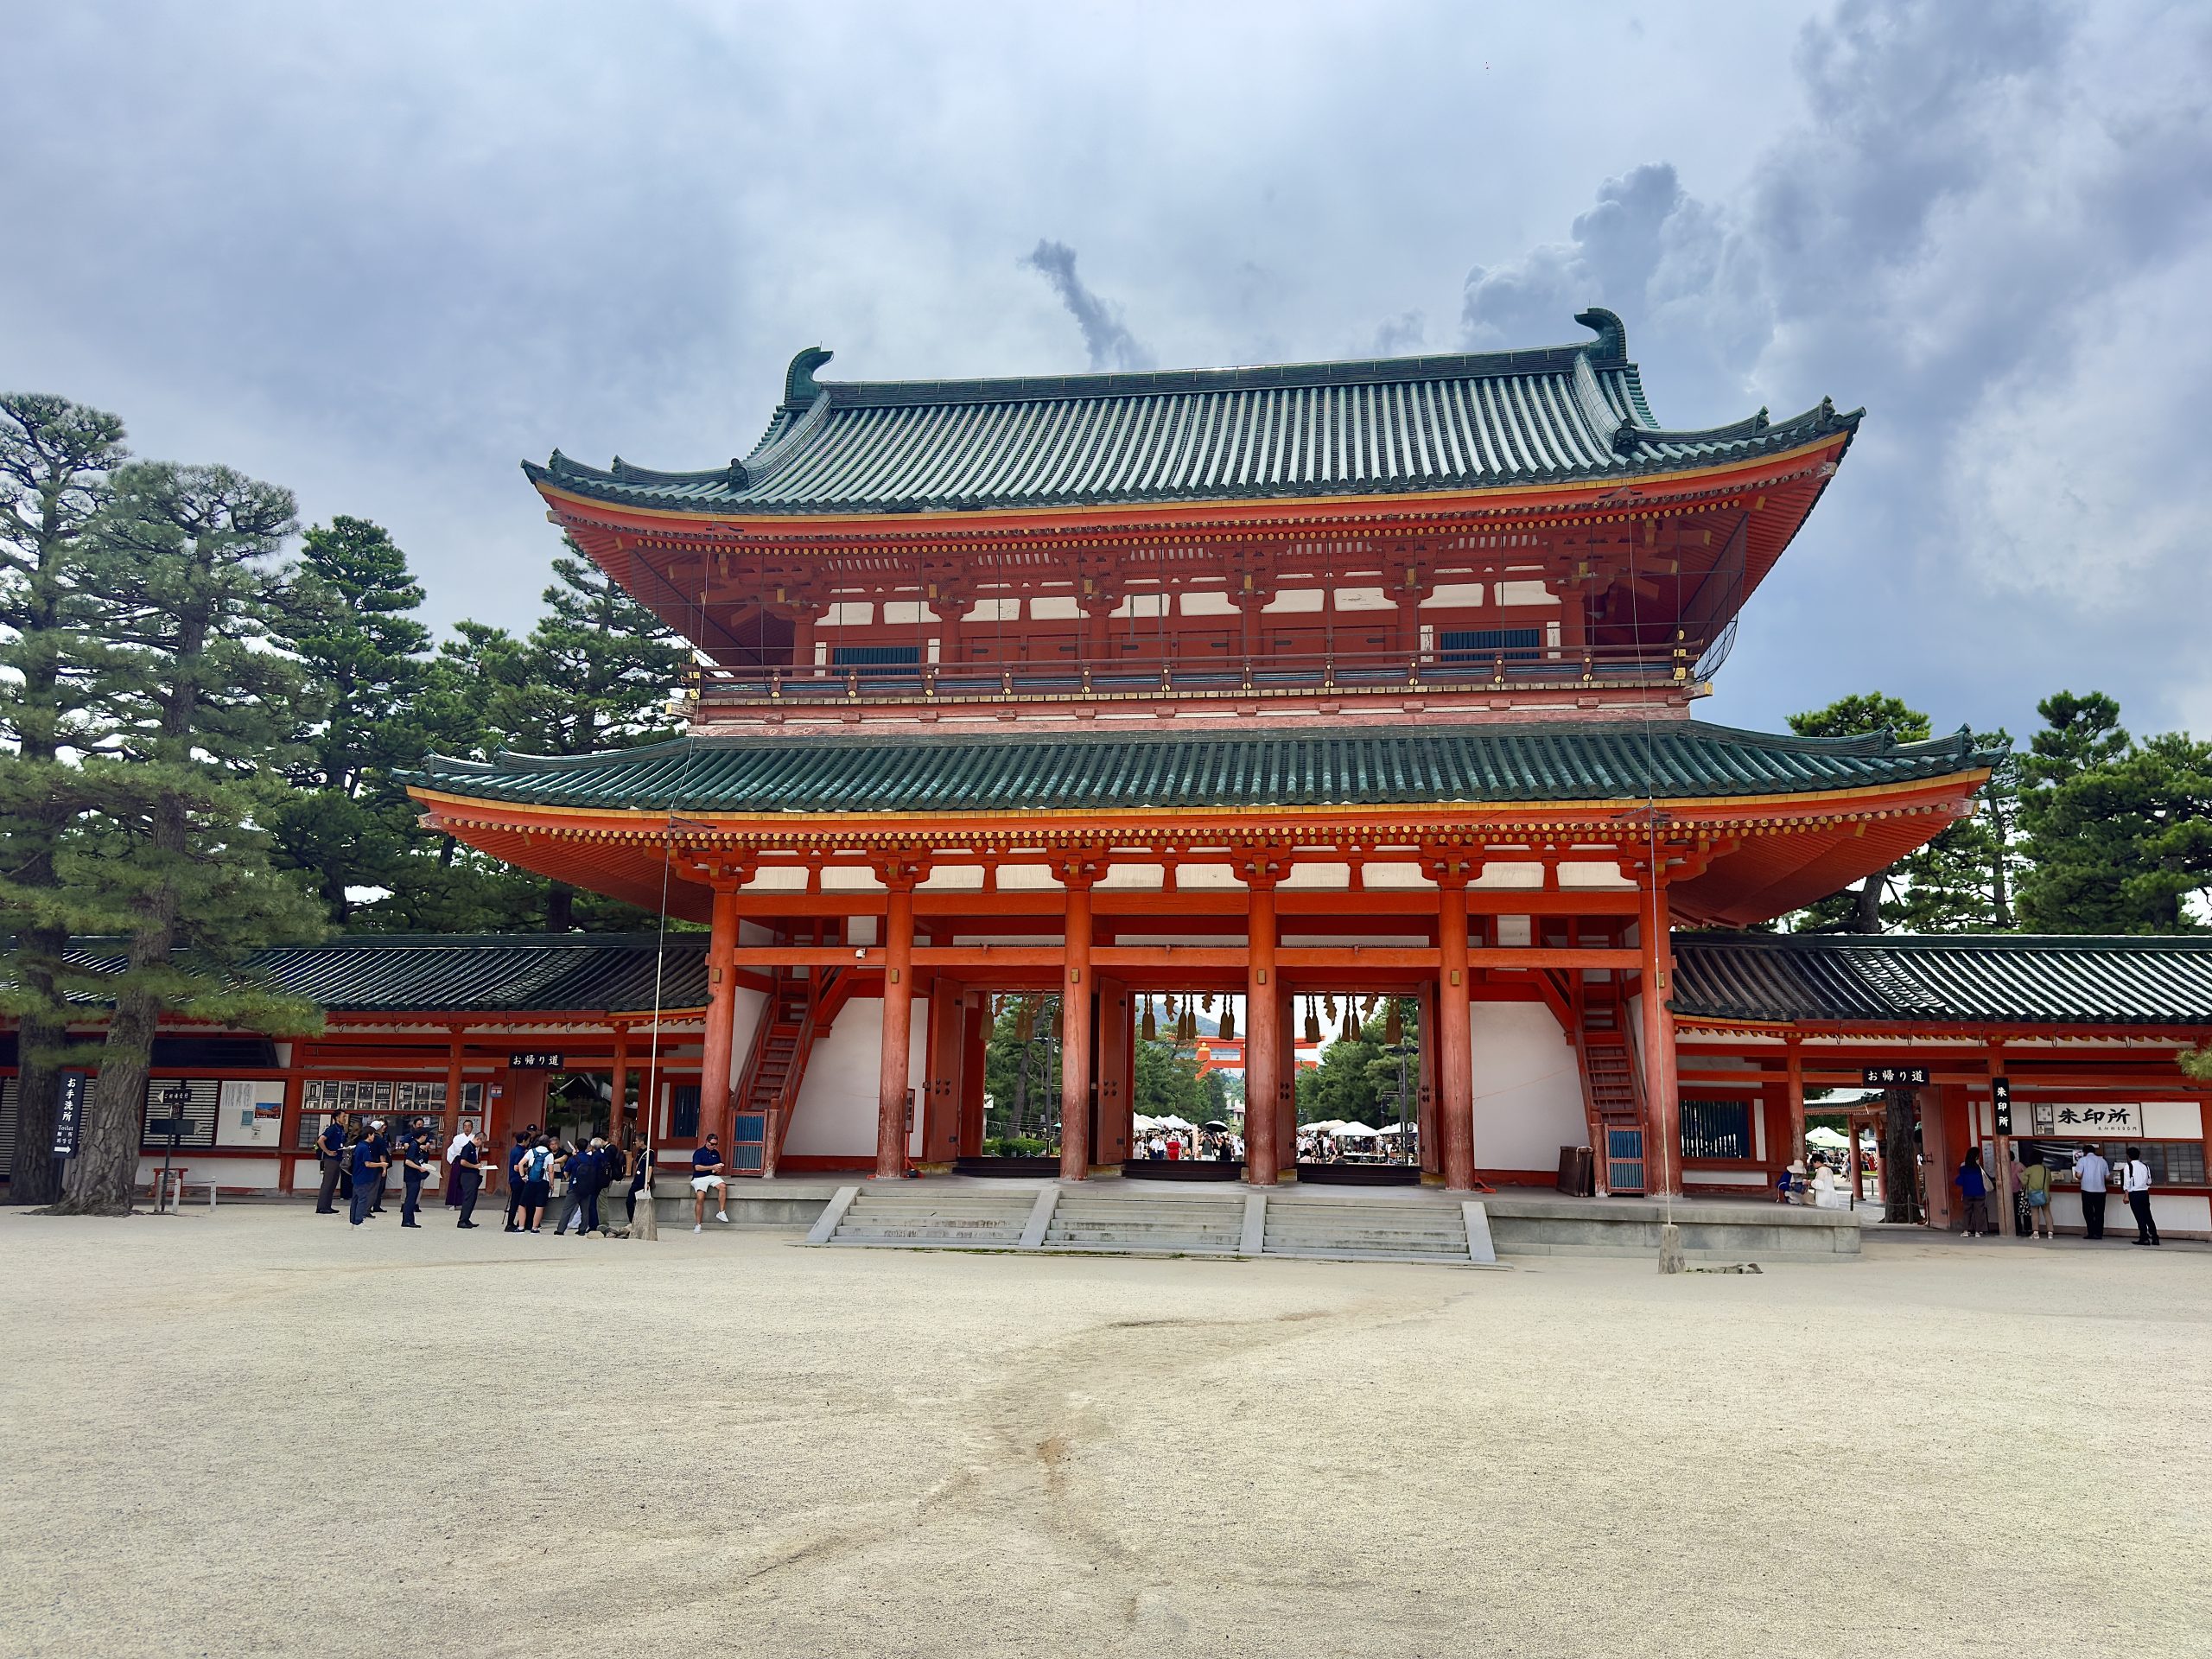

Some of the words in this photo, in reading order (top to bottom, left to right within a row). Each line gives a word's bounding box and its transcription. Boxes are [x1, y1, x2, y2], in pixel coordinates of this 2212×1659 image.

[512, 1054, 559, 1066] お帰り道
[1867, 1069, 1924, 1082] お帰り道
[62, 1077, 76, 1122] お手洗所
[1997, 1086, 2009, 1128] 朱印所
[2057, 1108, 2131, 1125] 朱印所
